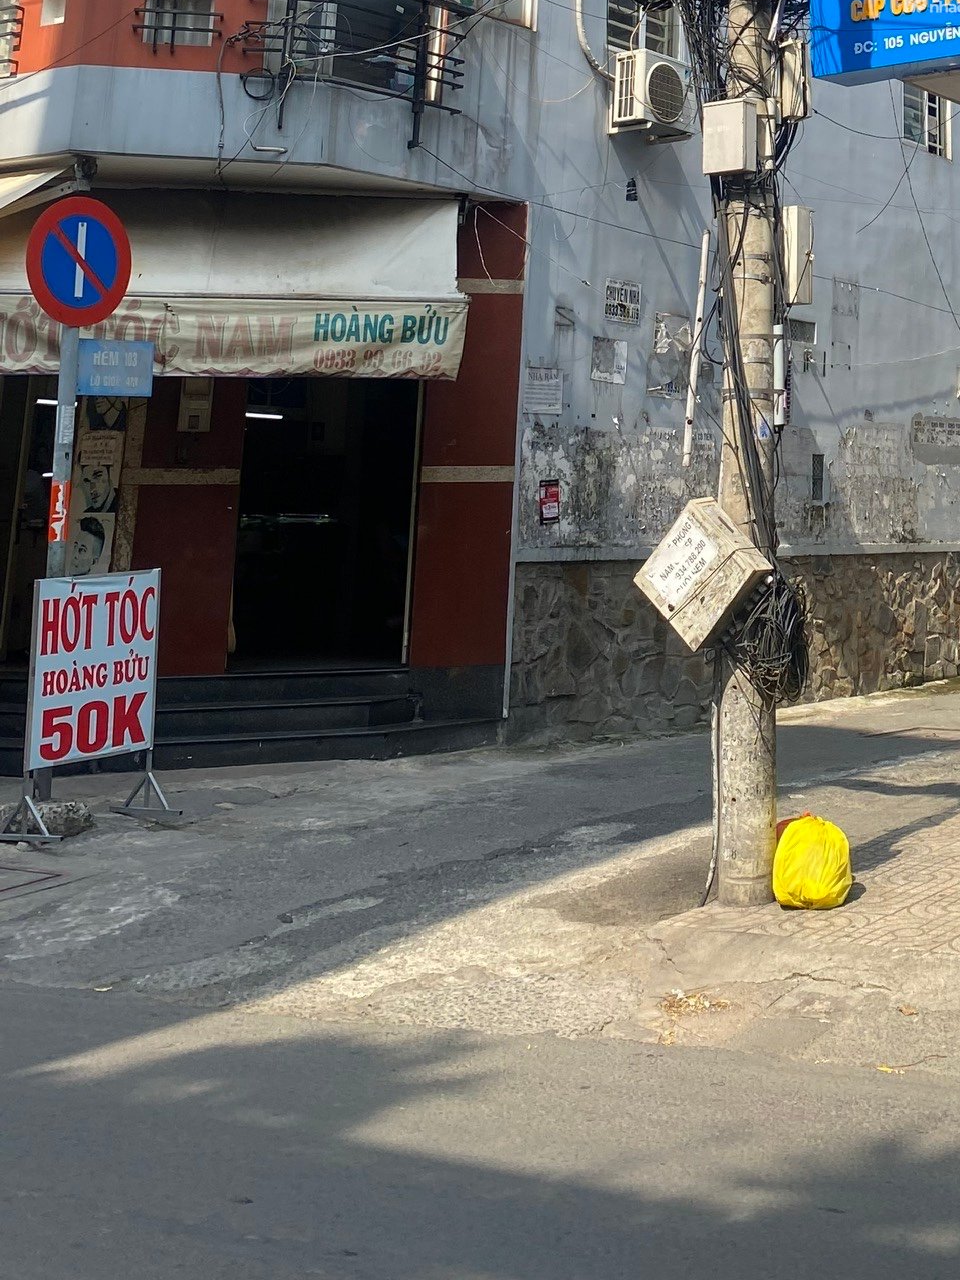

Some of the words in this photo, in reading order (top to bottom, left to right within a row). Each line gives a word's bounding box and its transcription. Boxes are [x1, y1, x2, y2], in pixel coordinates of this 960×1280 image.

[884, 35, 904, 50] 105
[0, 296, 60, 362] ỚT
[192, 314, 298, 365] NAM
[313, 305, 394, 344] HOÀNG
[400, 304, 449, 345] BỬU
[40, 583, 98, 656] HỚT
[104, 576, 156, 647] TÓC
[42, 660, 108, 697] HOÀNG
[112, 648, 150, 685] BỬU
[39, 691, 148, 761] 50K
